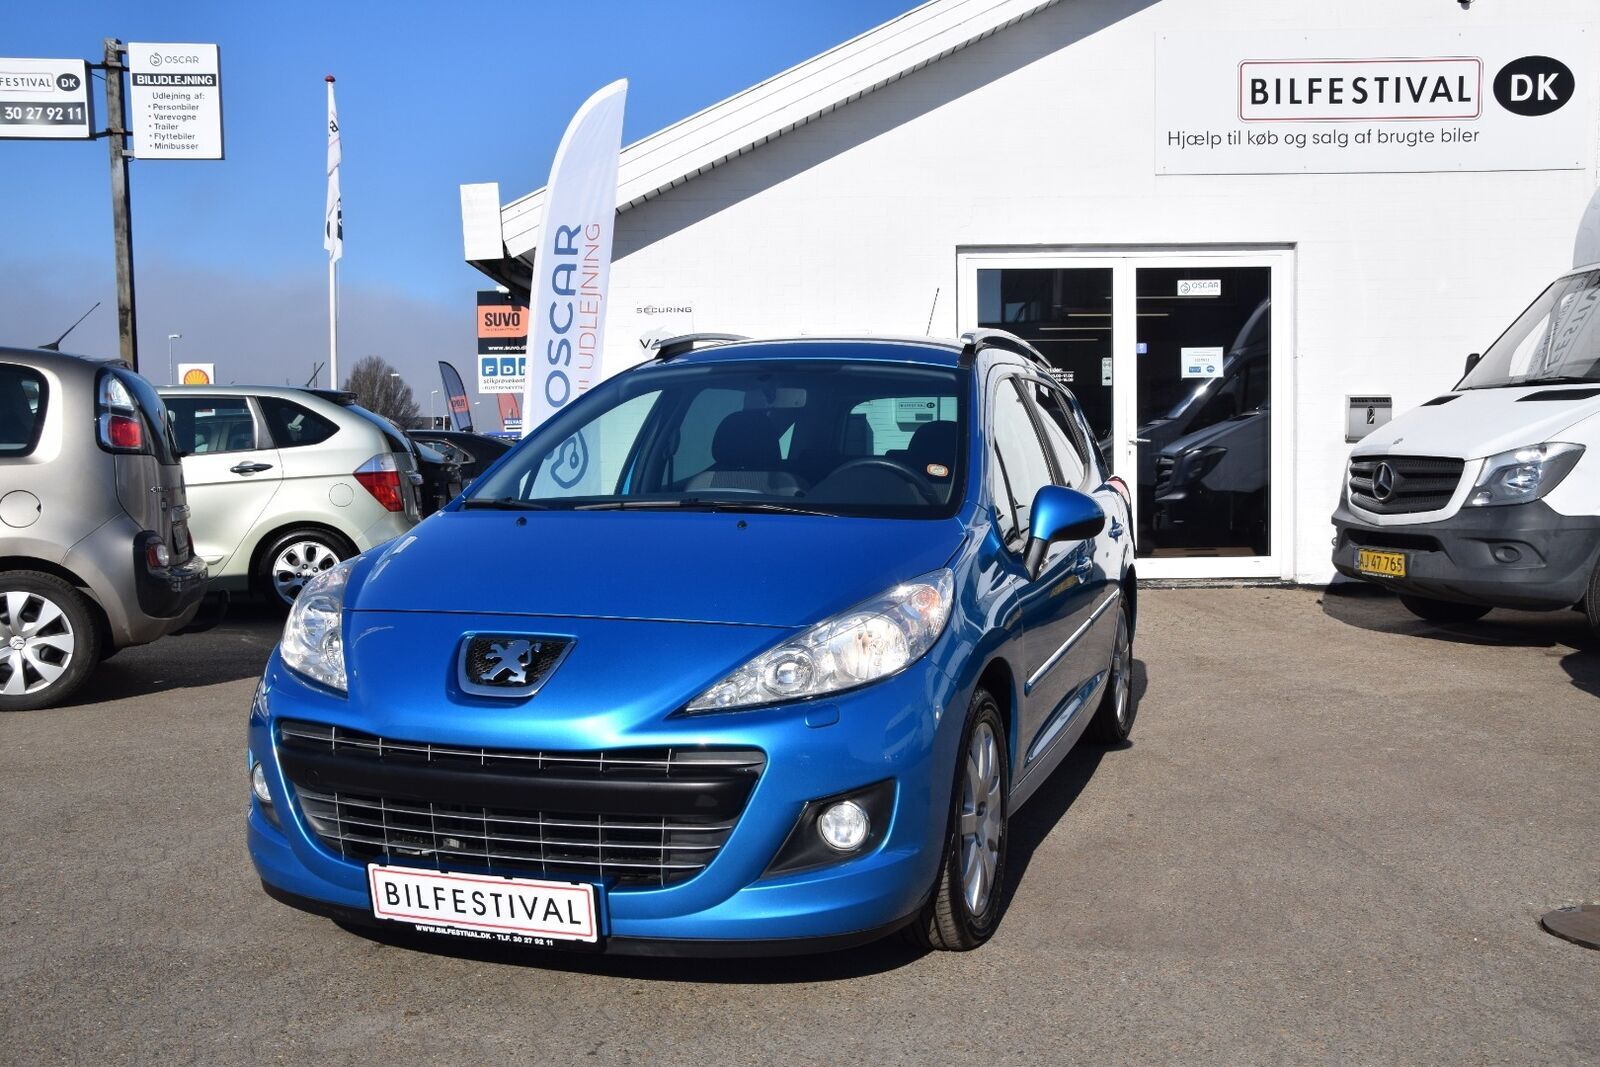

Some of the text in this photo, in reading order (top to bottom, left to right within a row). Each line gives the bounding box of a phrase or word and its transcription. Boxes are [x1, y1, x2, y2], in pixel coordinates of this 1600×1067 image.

[165, 55, 200, 64] OSCAR
[61, 78, 77, 88] DK
[136, 75, 213, 85] BILUDLEJNING
[1251, 72, 1560, 105] BILFESTIVAL DK
[152, 92, 205, 101] Udlejning af:
[4, 106, 82, 120] 30 27 92 11
[153, 113, 197, 121] Varevogne
[154, 132, 196, 141] Flyttebiler
[1167, 127, 1480, 150] Hjælp til køb og salg af brugte biler
[545, 223, 582, 408] OSCAR
[1360, 554, 1402, 572] AJ 47 765
[384, 881, 582, 925] BILFESTIVAL
[415, 924, 491, 940] WWW.BILFESTIVAL.DK
[497, 934, 511, 942] TLF.
